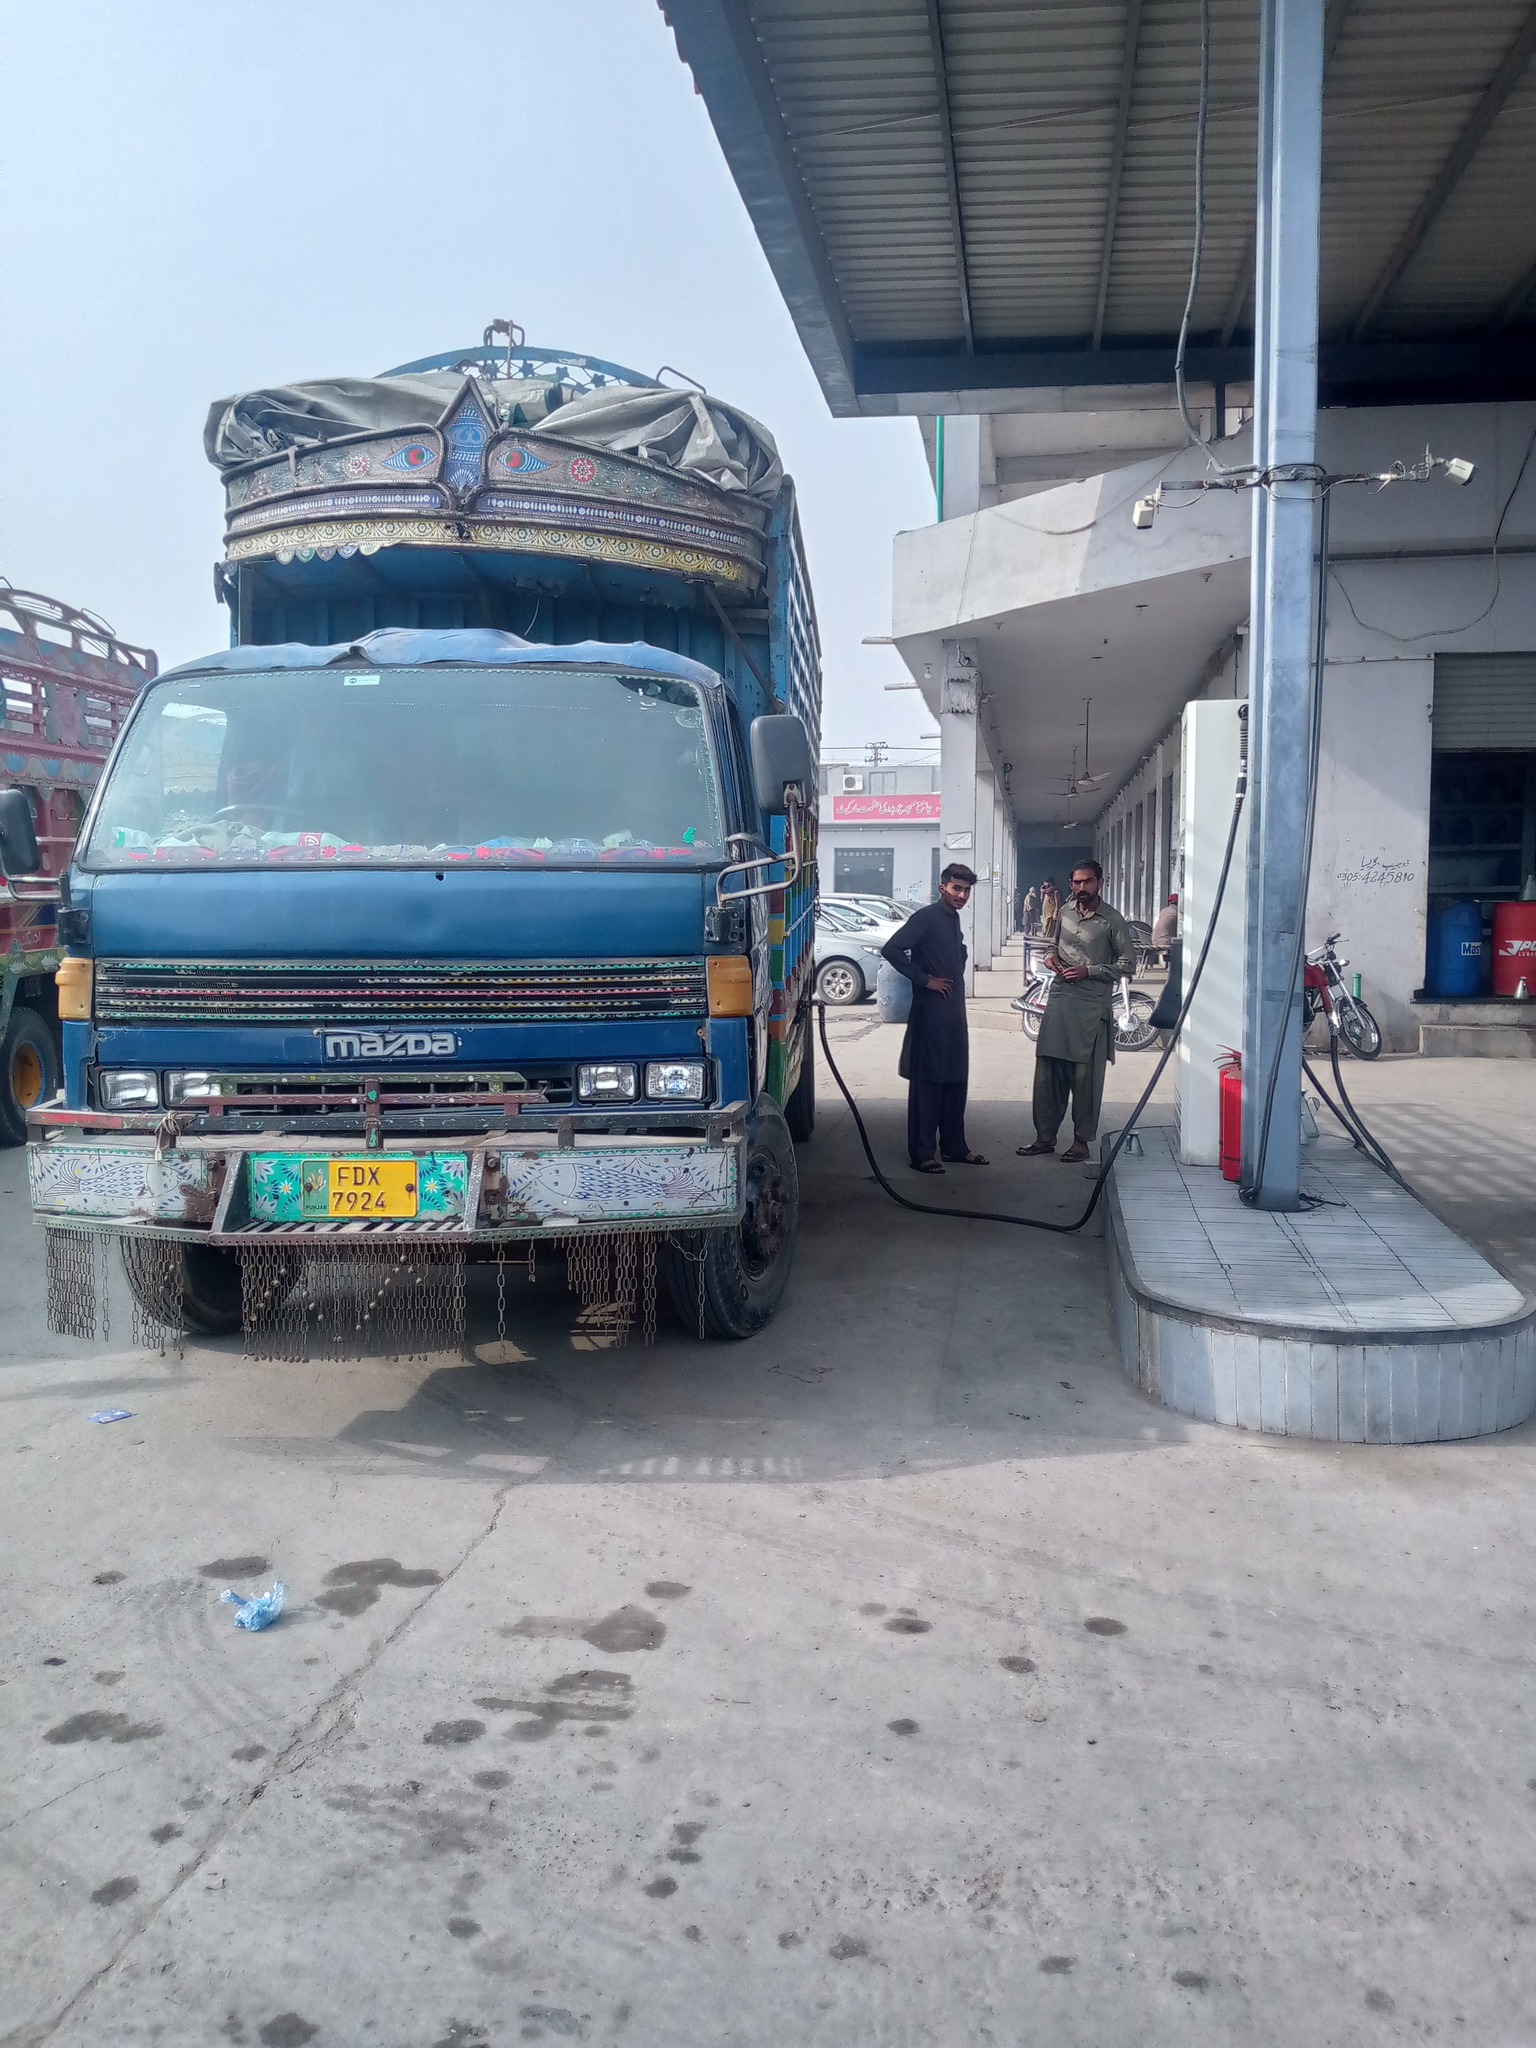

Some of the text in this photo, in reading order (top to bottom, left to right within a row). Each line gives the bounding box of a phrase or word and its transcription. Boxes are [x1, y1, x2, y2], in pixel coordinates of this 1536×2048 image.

[337, 1165, 381, 1187] FDX
[305, 1204, 328, 1212] PUNJAB
[332, 1190, 387, 1212] 7924
